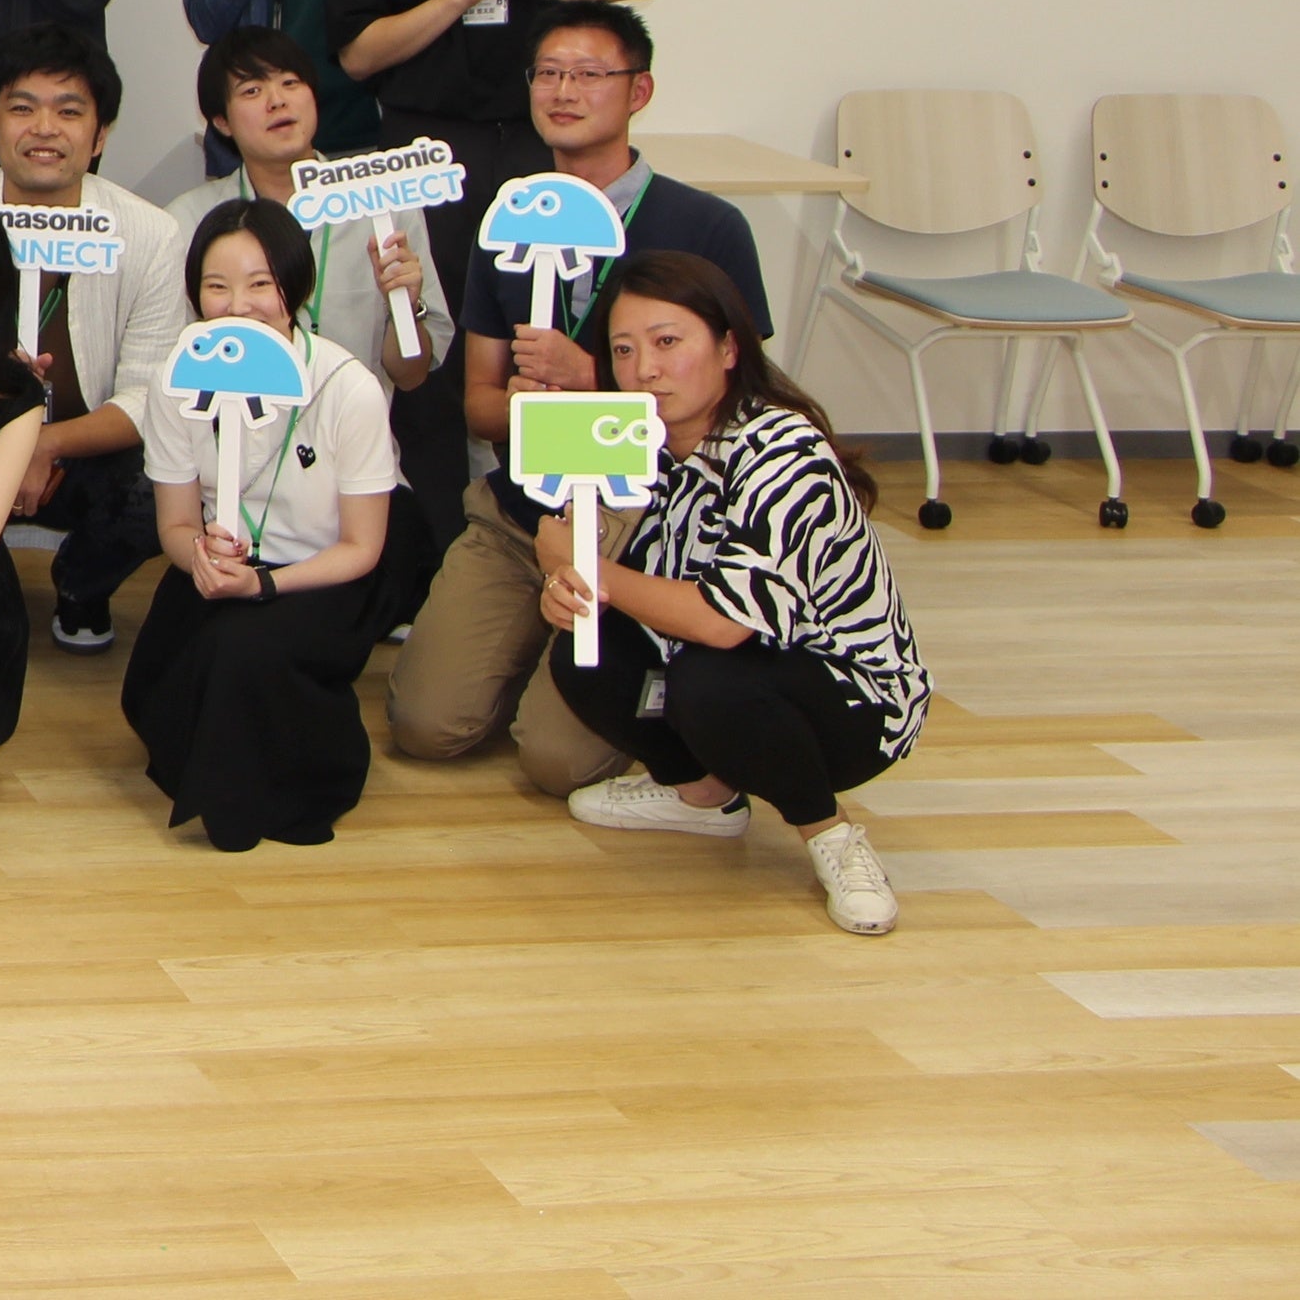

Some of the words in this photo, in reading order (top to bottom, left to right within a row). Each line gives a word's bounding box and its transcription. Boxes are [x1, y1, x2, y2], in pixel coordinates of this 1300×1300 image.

[298, 144, 446, 189] Panasonic
[293, 170, 460, 223] CONNECT
[9, 239, 119, 268] NNECT
